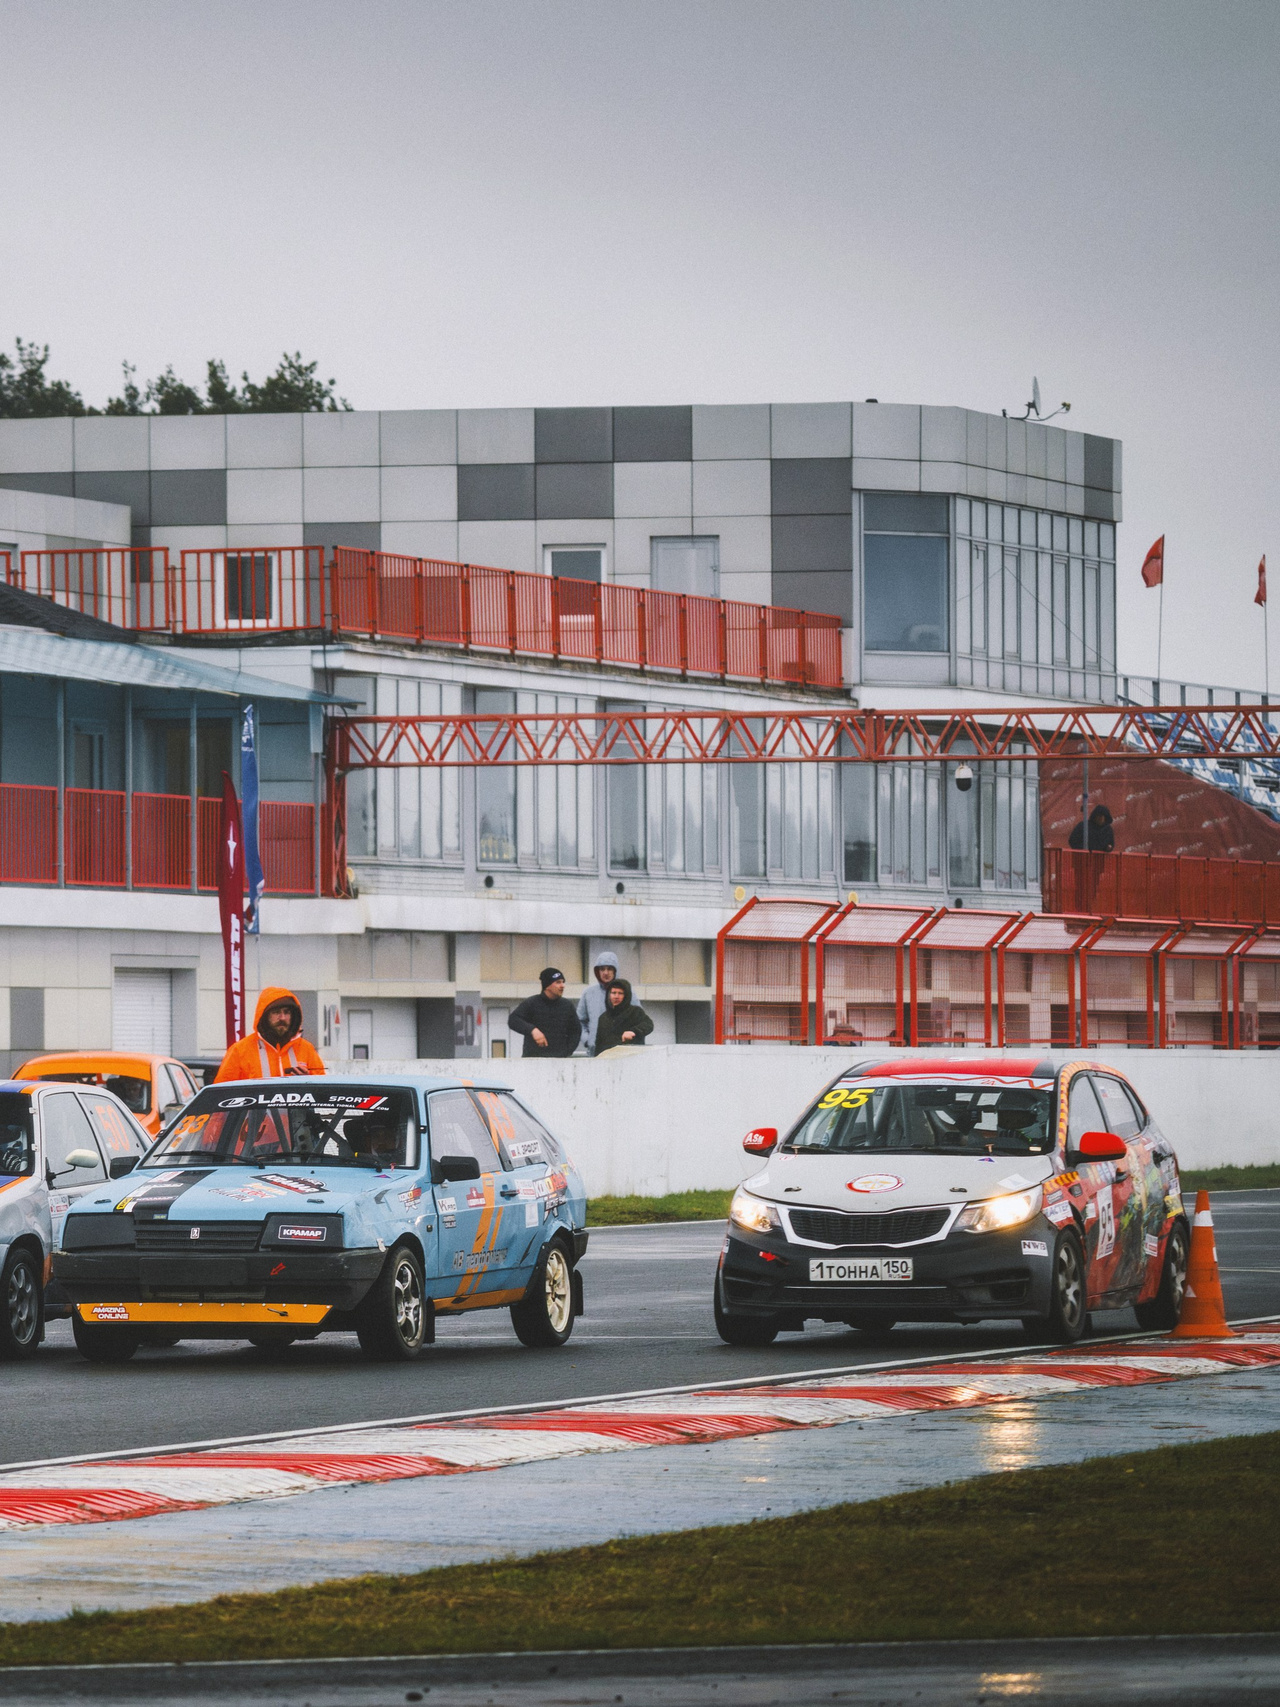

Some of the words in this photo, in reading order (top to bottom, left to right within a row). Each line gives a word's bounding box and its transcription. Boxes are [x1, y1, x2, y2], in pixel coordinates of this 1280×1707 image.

[258, 1092, 316, 1105] LADA
[328, 1095, 370, 1104] SPORT
[817, 1088, 876, 1109] 95
[94, 1104, 131, 1152] 50
[173, 1113, 210, 1136] 33
[283, 1228, 322, 1238] КРАМАР
[1022, 1240, 1047, 1252] NWB
[815, 1261, 881, 1279] 1ТОННА
[884, 1260, 909, 1274] 150
